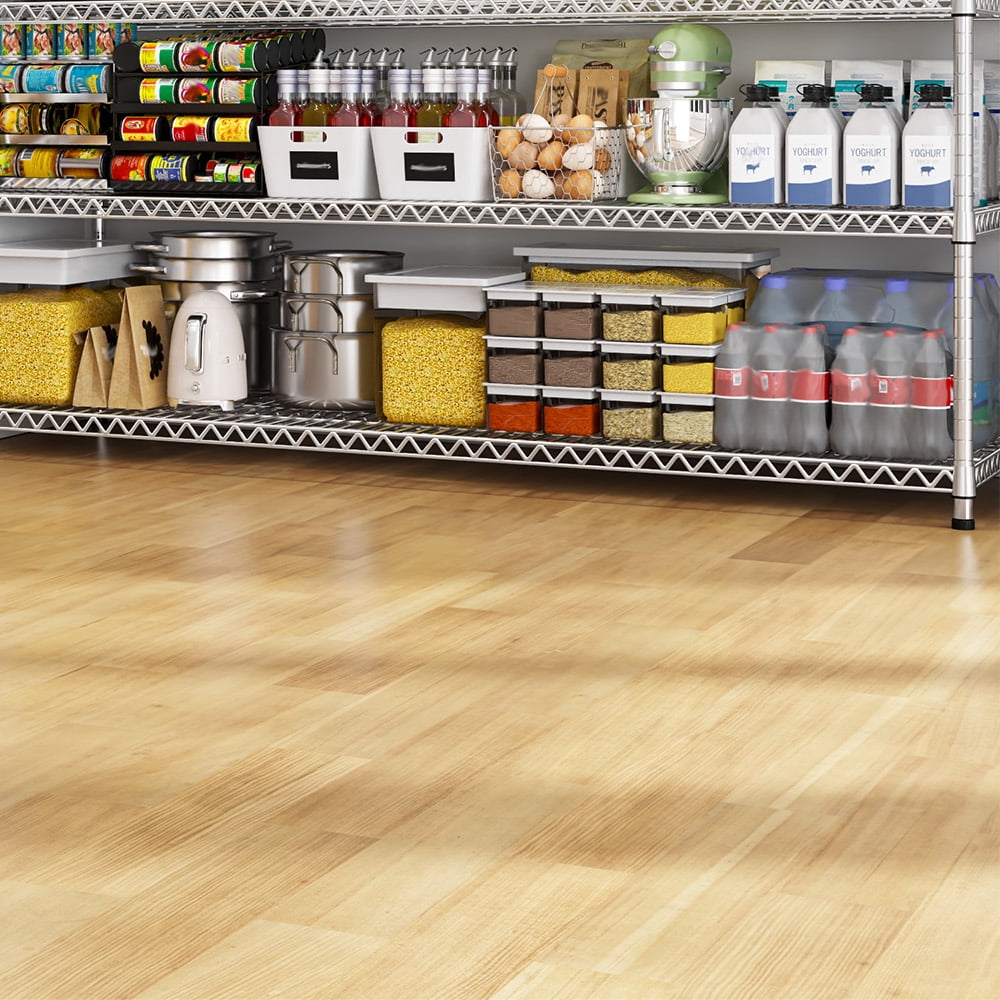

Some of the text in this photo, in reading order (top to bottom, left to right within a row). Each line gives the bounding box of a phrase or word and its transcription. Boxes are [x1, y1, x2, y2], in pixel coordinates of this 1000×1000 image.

[736, 147, 770, 157] YOGHURT
[793, 147, 828, 157] YOGHURT
[850, 147, 887, 158] YOGHURT
[910, 148, 947, 158] YOGHURT
